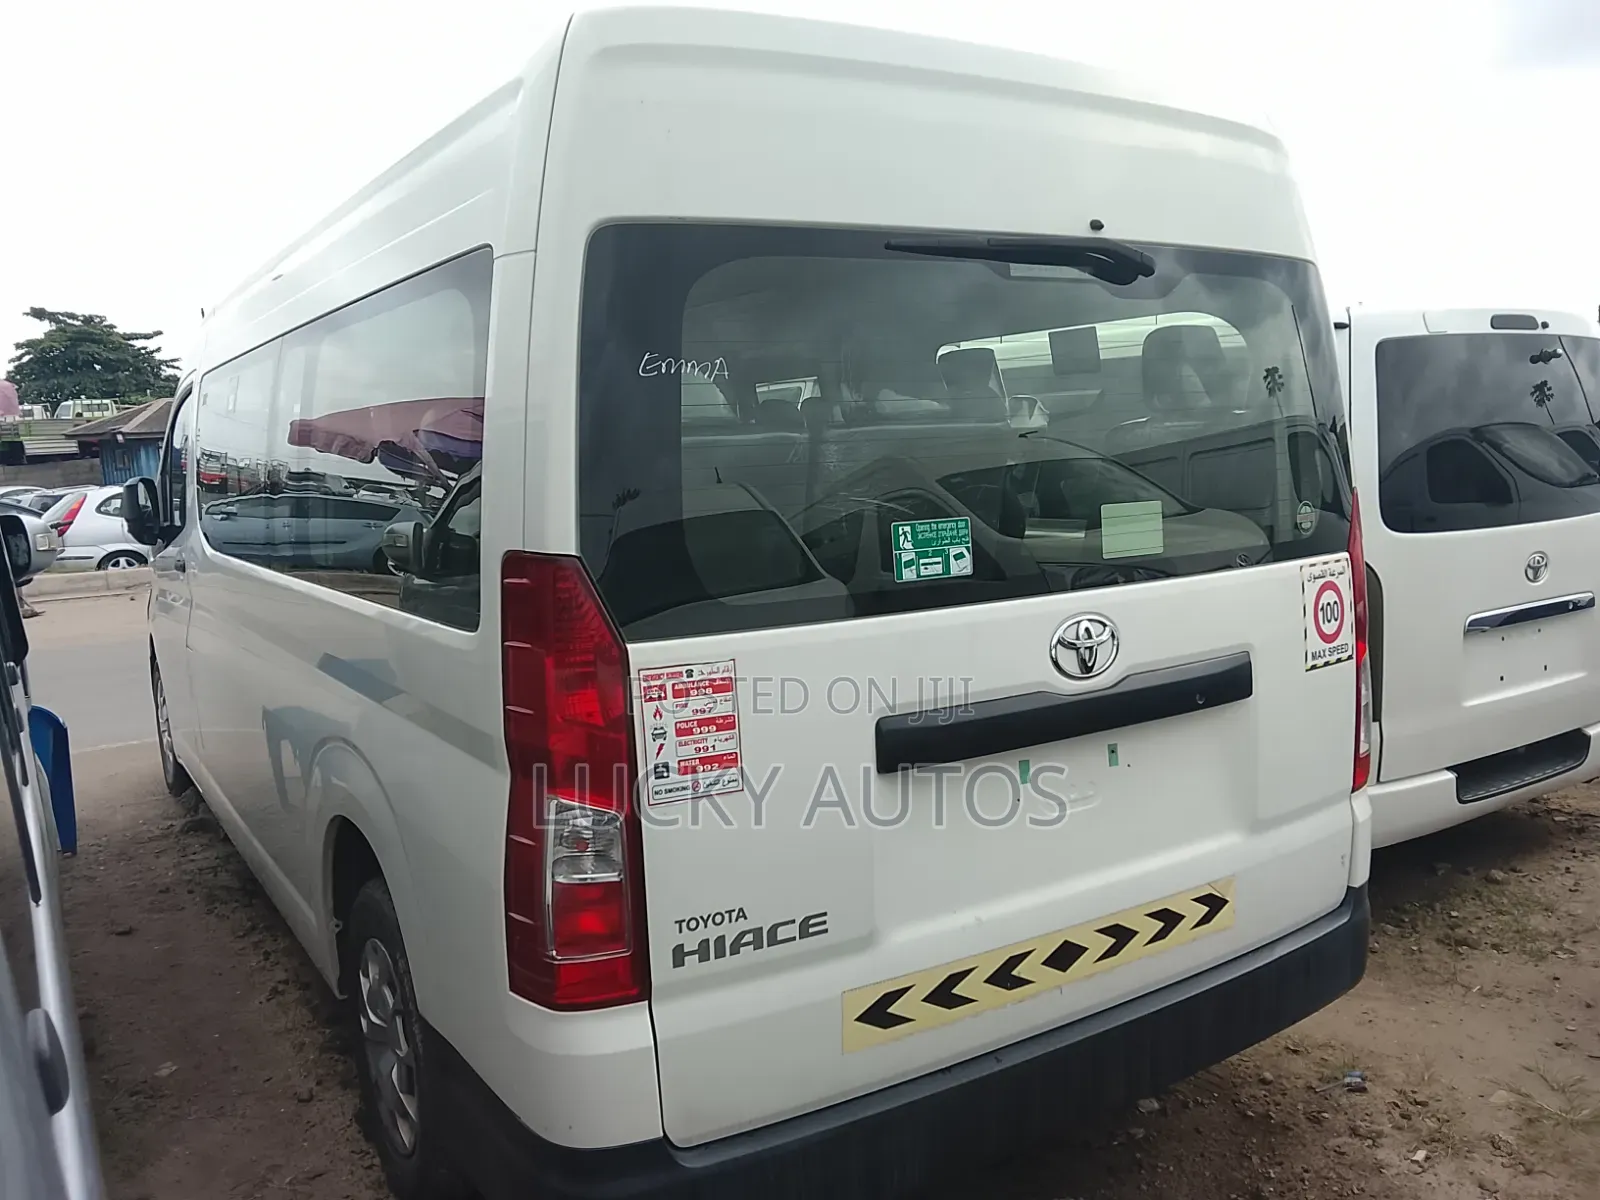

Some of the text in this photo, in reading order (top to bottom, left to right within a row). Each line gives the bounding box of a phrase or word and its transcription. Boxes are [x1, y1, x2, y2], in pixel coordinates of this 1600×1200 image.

[1319, 600, 1340, 625] 100
[1311, 643, 1349, 661] MAX SPEED
[690, 687, 713, 696] 998
[692, 706, 714, 716] 997
[676, 720, 698, 730] POLICE
[692, 725, 717, 734] 999
[678, 737, 708, 747] ELECTRICITY
[694, 744, 717, 753] 991
[680, 758, 700, 767] WATER
[696, 763, 719, 772] 992
[664, 785, 690, 795] SMOKING
[674, 907, 748, 935] TOYOTA
[671, 911, 829, 969] HIACE
